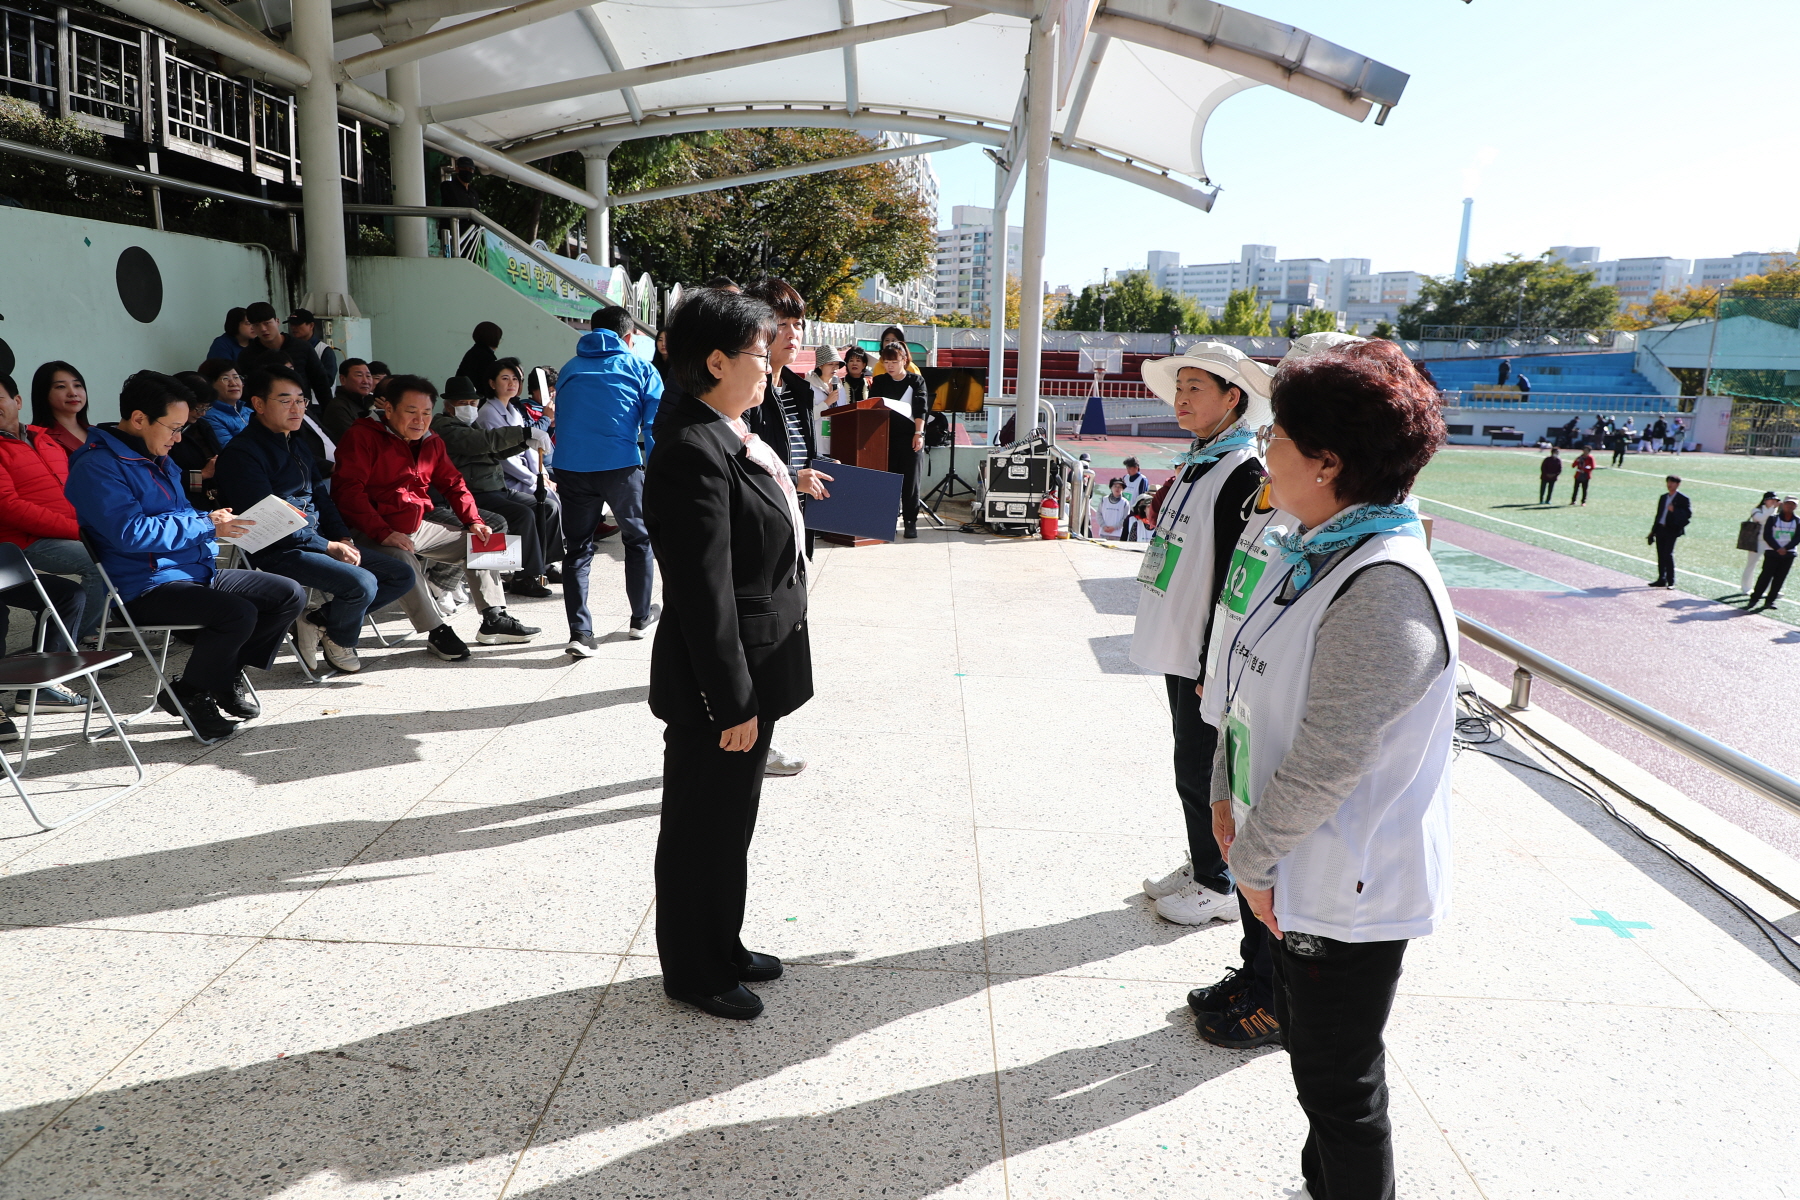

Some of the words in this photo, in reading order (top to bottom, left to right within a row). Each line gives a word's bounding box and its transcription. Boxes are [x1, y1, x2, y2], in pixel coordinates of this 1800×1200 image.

[507, 256, 531, 289] 우리
[534, 264, 557, 293] 함께
[1198, 898, 1211, 908] FILA
